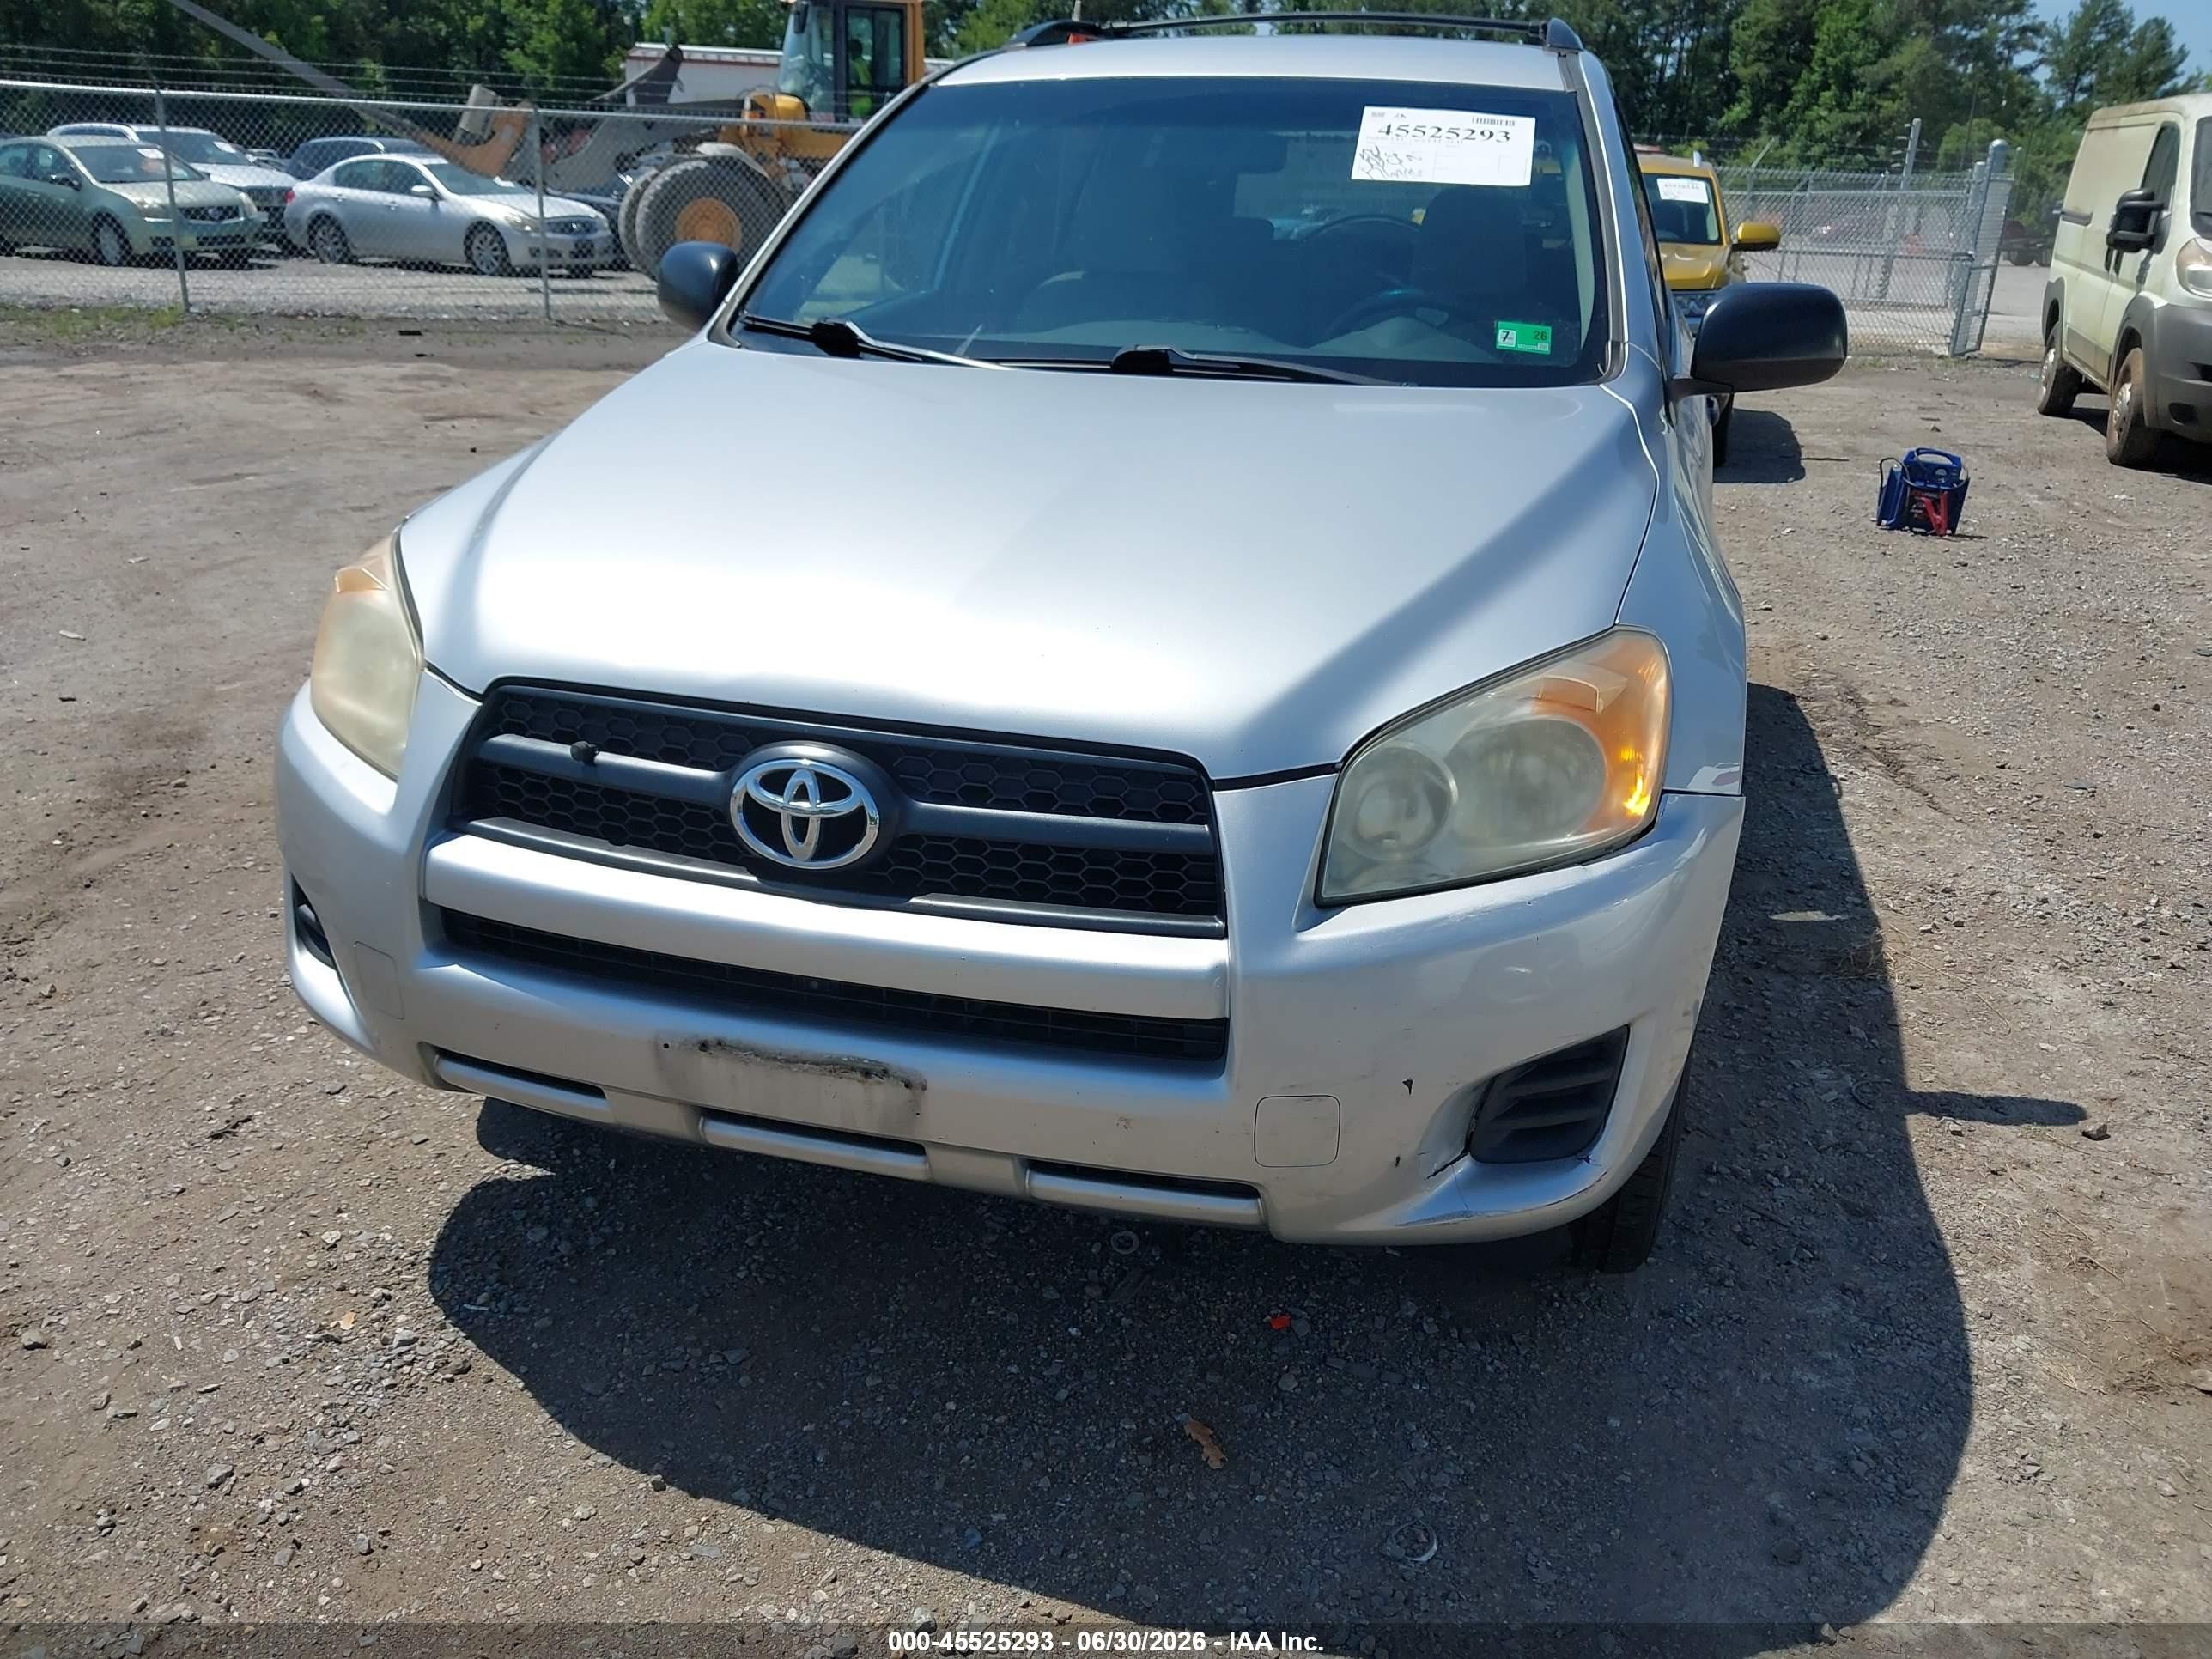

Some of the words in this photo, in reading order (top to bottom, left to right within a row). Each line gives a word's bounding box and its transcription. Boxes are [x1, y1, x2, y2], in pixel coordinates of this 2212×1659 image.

[1377, 123, 1510, 143] 45525293
[1502, 330, 1510, 342] 7
[1533, 330, 1547, 341] 26
